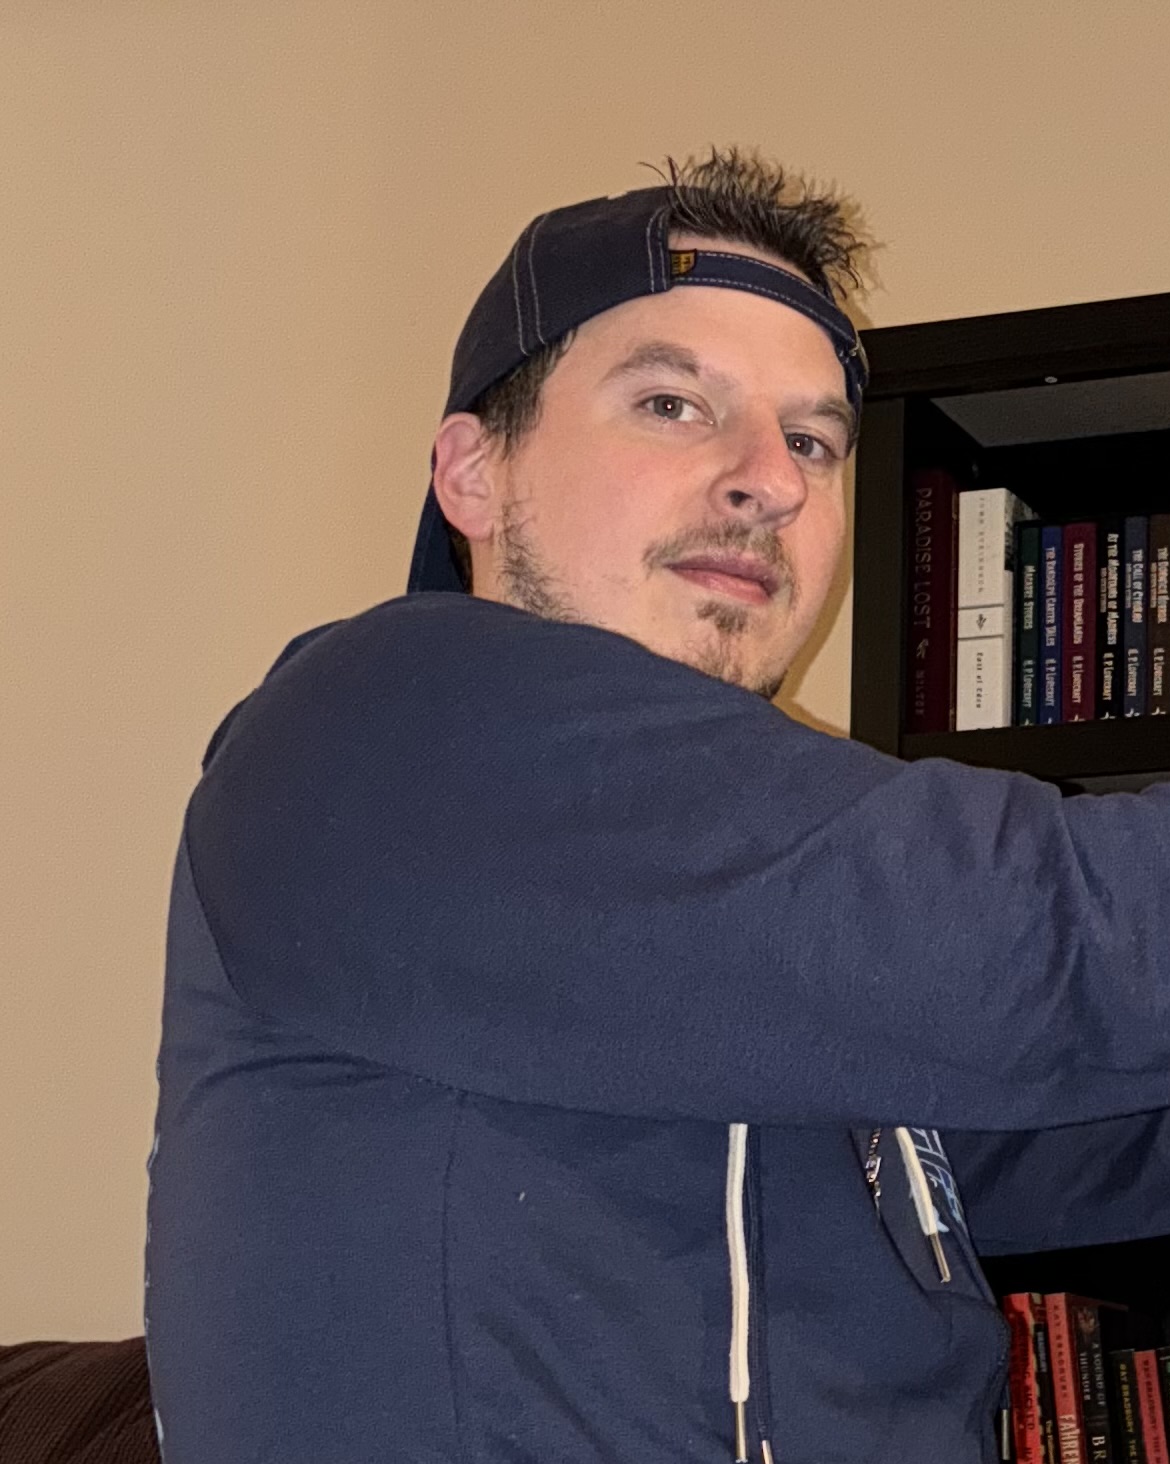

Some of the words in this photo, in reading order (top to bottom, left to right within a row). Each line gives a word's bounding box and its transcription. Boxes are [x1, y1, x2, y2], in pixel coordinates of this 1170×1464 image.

[914, 488, 932, 573] PARADISE
[1132, 563, 1143, 580] CALL
[912, 581, 931, 628] LOST
[1080, 1352, 1091, 1401] THUNDER
[1121, 1384, 1134, 1433] BRADBURY
[1128, 1439, 1137, 1457] THE
[1152, 1436, 1161, 1453] THE
